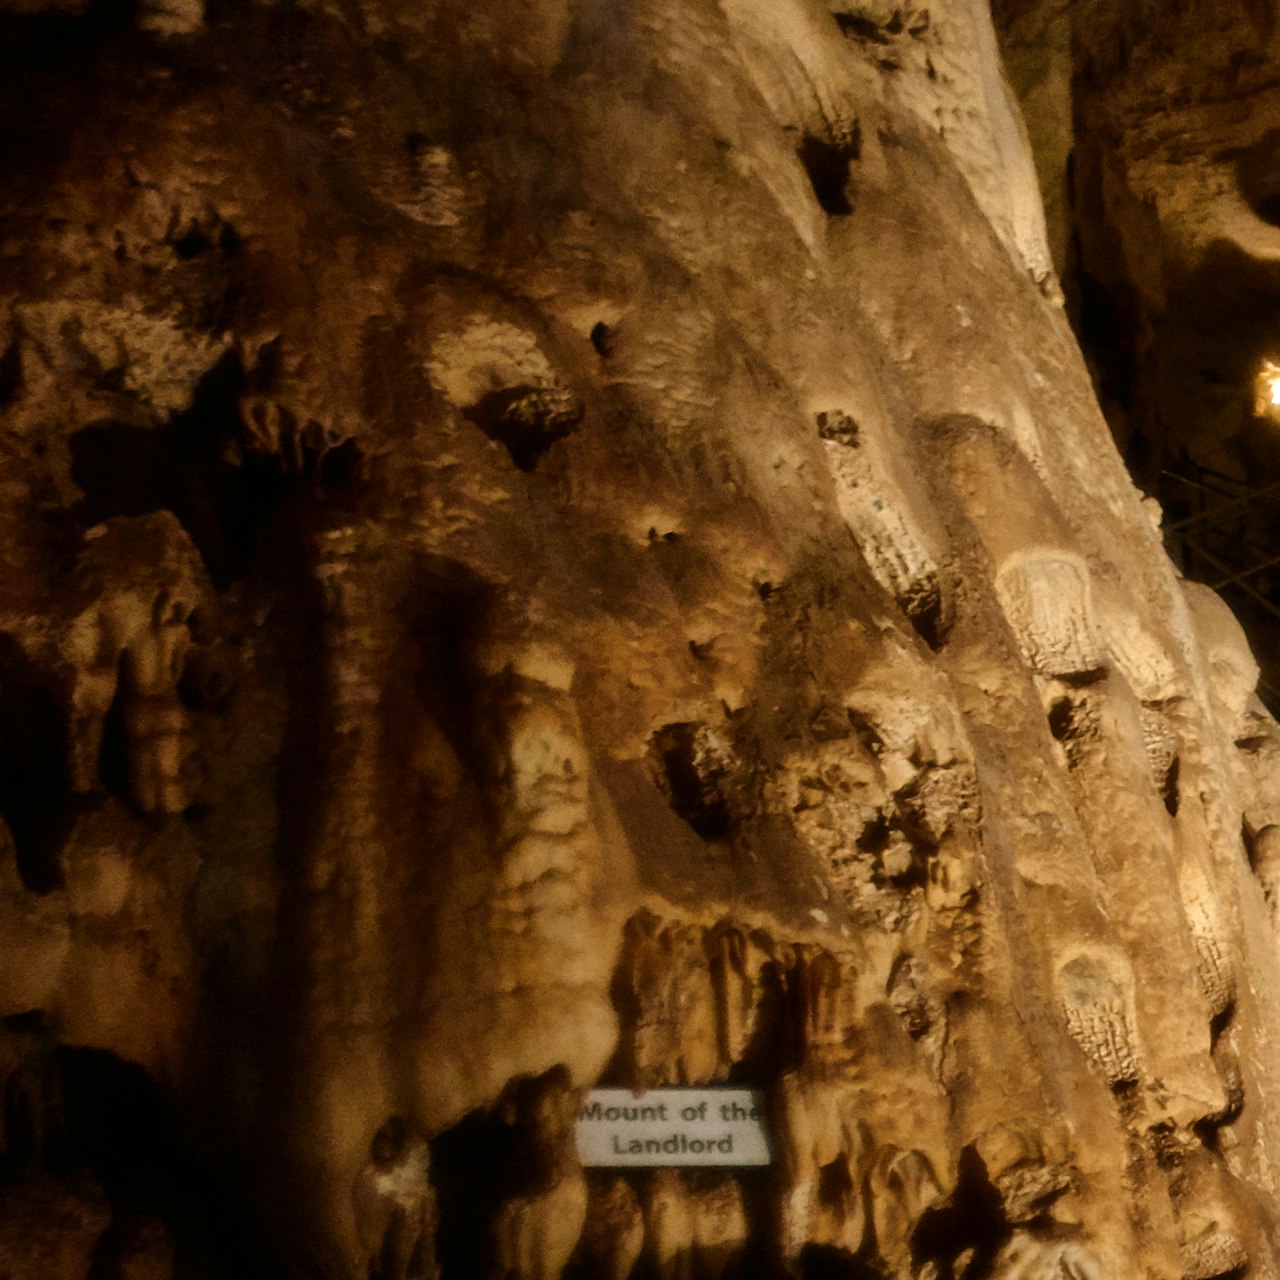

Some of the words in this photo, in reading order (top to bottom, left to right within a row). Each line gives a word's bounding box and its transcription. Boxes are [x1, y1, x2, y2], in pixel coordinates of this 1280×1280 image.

[579, 1101, 668, 1122] Mount
[680, 1101, 709, 1122] of
[719, 1101, 764, 1122] the
[612, 1134, 733, 1154] Landlord
